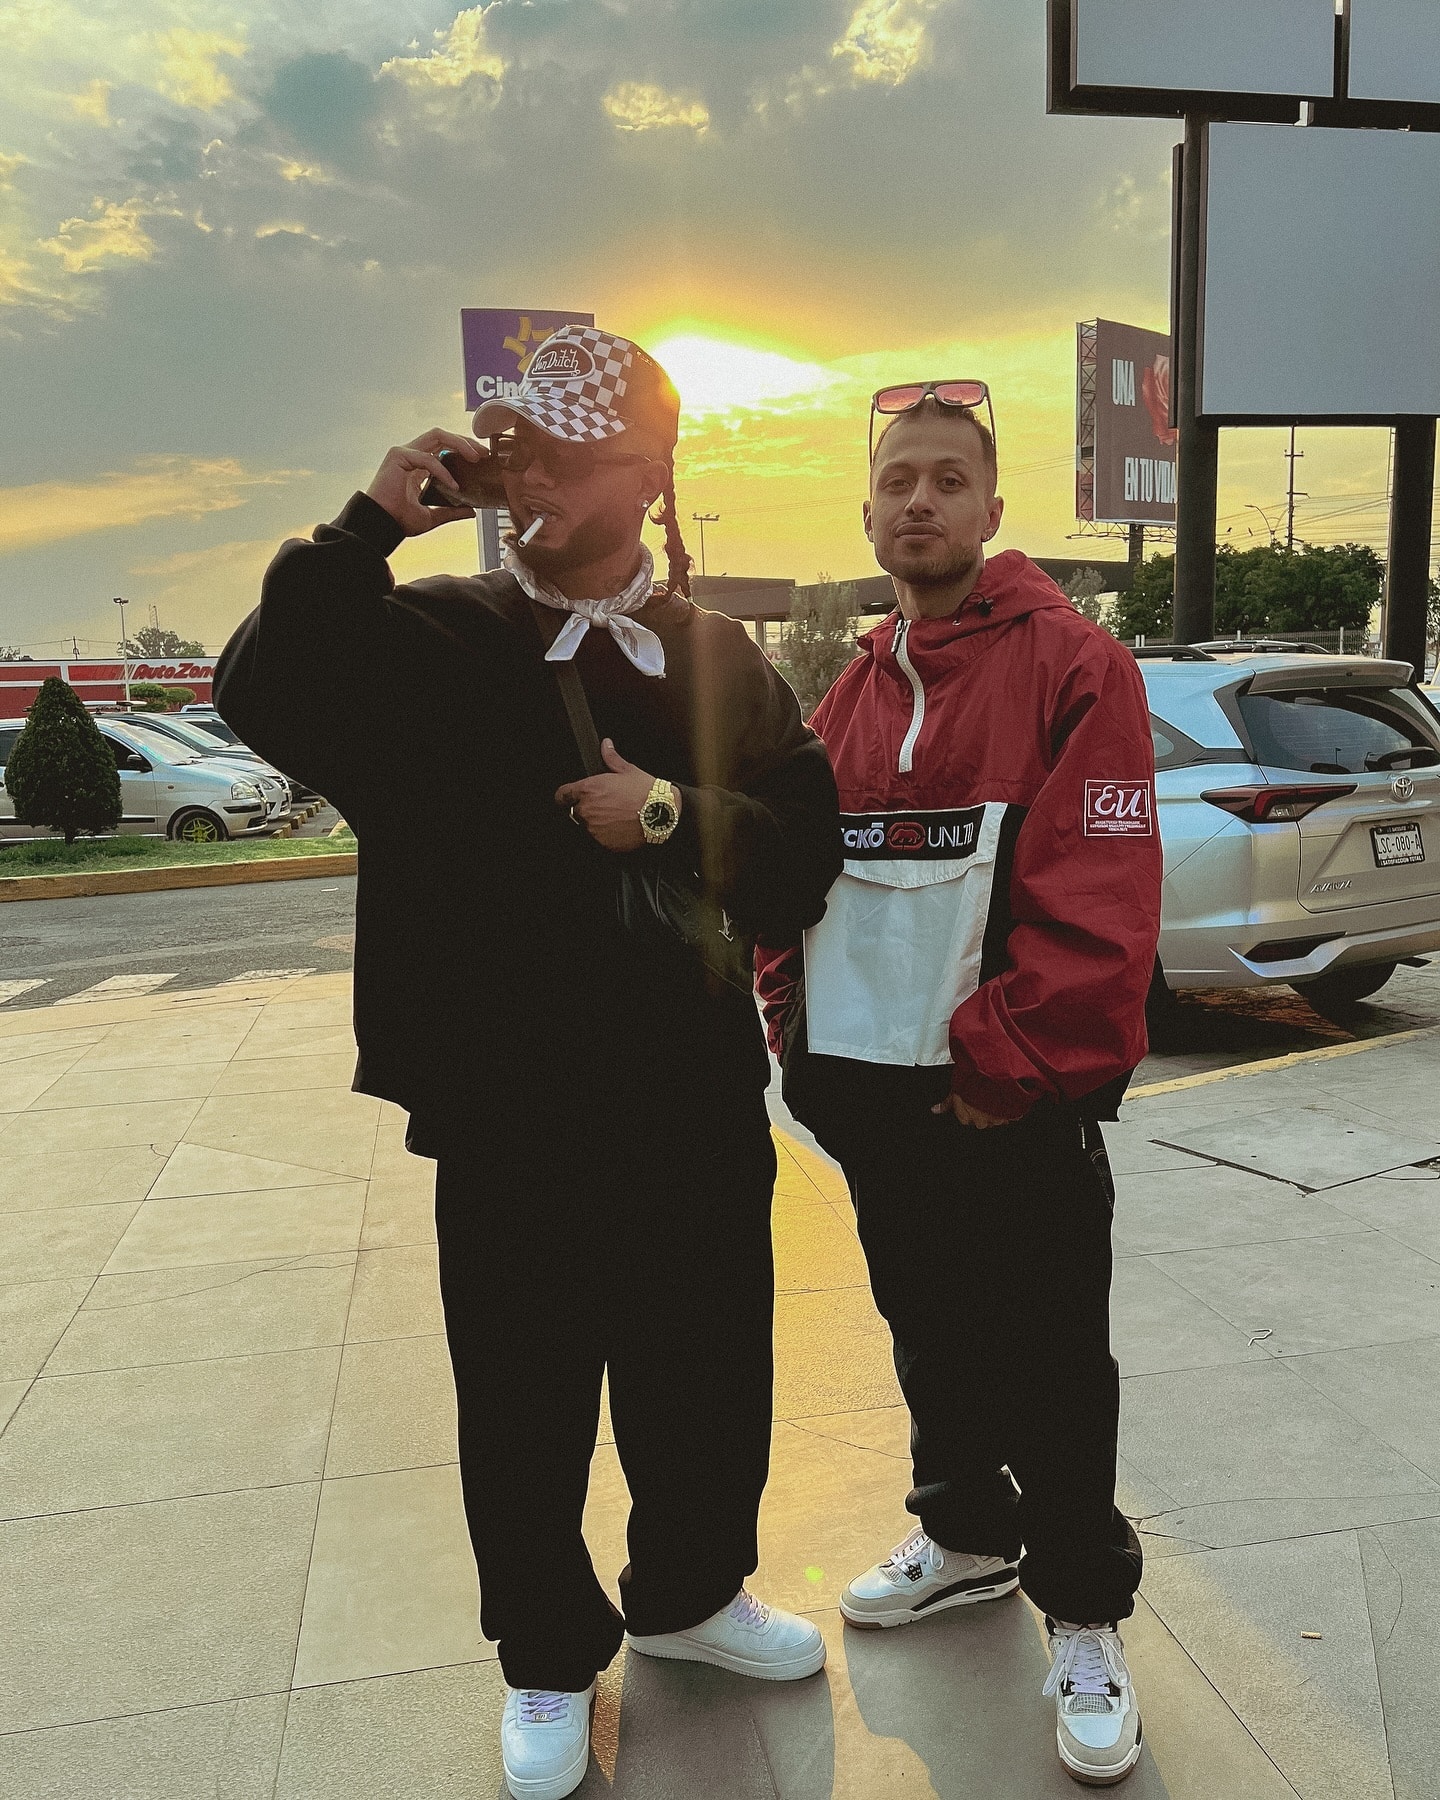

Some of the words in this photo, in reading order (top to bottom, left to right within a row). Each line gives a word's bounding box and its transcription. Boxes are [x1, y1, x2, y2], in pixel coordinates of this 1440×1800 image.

[545, 349, 579, 370] Dutch
[476, 375, 521, 399] Cin
[1112, 358, 1136, 406] UNA
[1125, 457, 1139, 501] EN
[1140, 458, 1153, 503] TU
[133, 663, 215, 679] AutoZon
